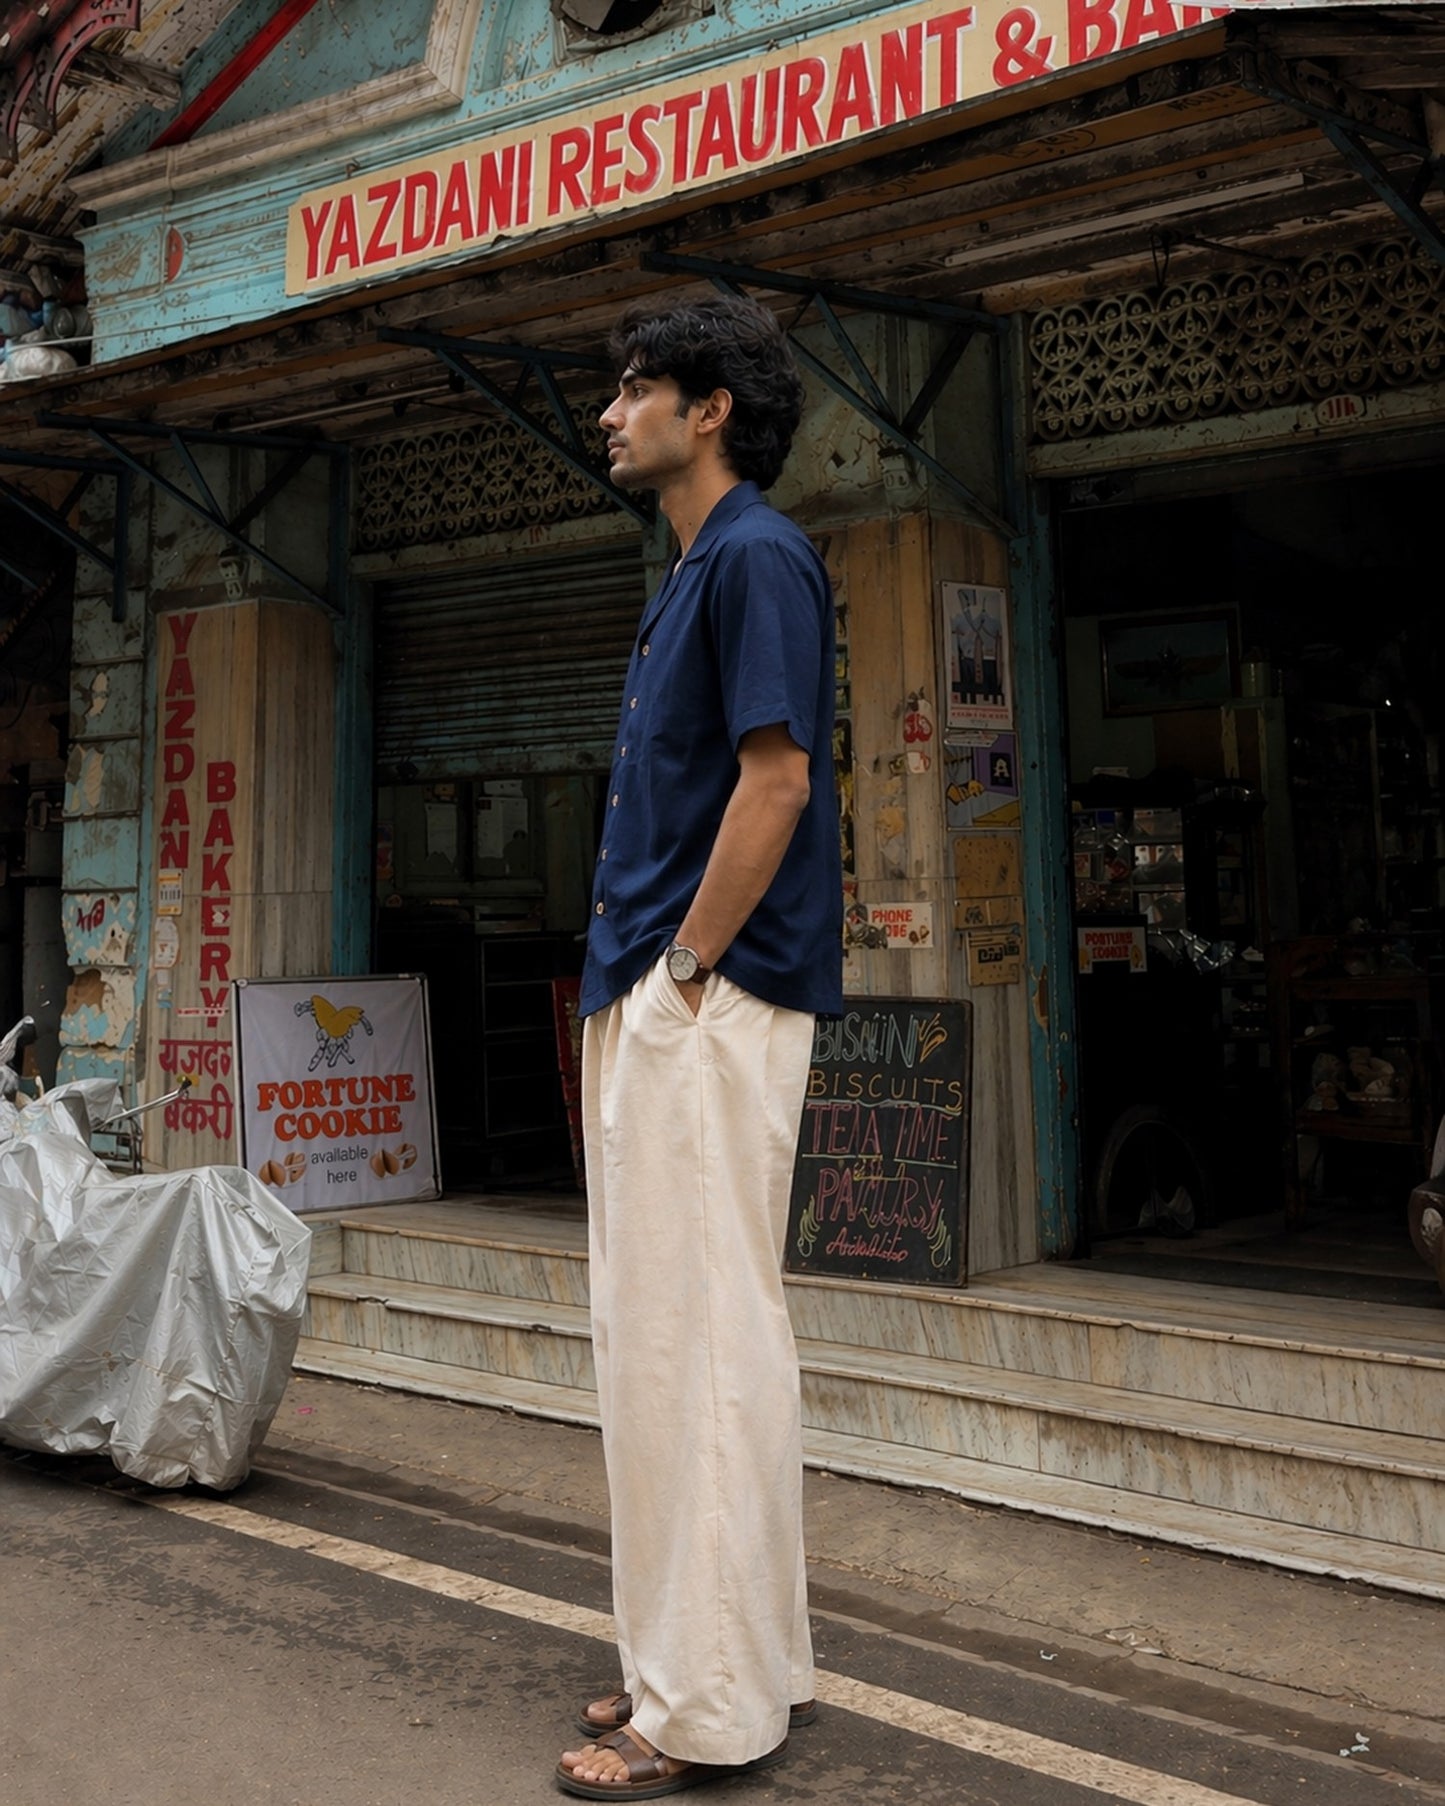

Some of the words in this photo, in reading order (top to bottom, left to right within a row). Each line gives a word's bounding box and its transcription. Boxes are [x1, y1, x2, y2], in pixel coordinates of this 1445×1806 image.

[301, 139, 534, 281] YAZDANI
[547, 5, 976, 217] RESTAURANT
[991, 6, 1055, 88] &
[1067, 0, 1232, 67] BA
[199, 760, 237, 1028] BAKERY
[256, 1073, 417, 1112] FORTUNE
[807, 1069, 964, 1112] BISCUITS
[273, 1105, 403, 1142] COOKIE
[310, 1144, 369, 1165] available
[326, 1168, 358, 1185] here
